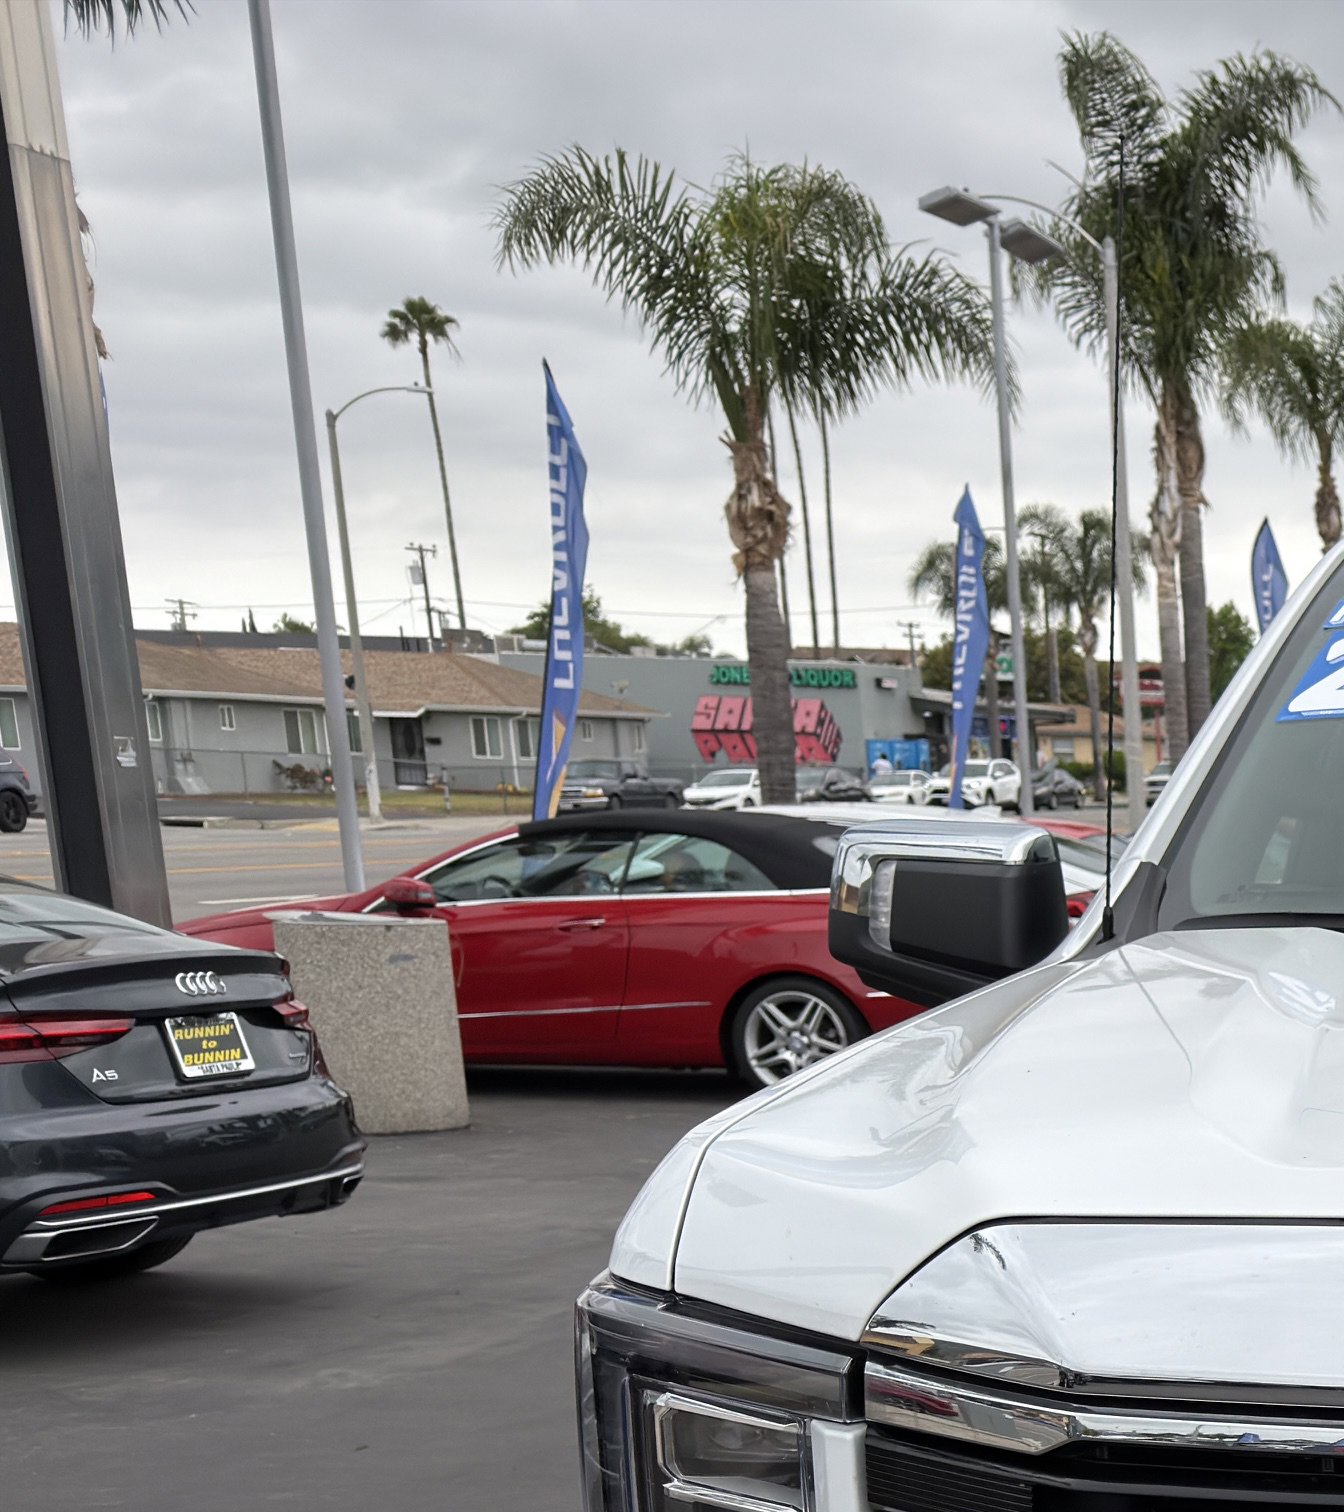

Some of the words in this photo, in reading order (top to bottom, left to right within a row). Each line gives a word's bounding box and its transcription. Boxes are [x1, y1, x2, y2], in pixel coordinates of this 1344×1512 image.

[710, 665, 751, 686] JONE
[790, 668, 857, 688] LIQUOR
[691, 694, 822, 731] SAA
[691, 731, 834, 764] PAA
[174, 1023, 235, 1041] RUNNIN'
[201, 1039, 218, 1050] to
[183, 1047, 242, 1067] BUNNIN
[92, 1068, 119, 1084] A5
